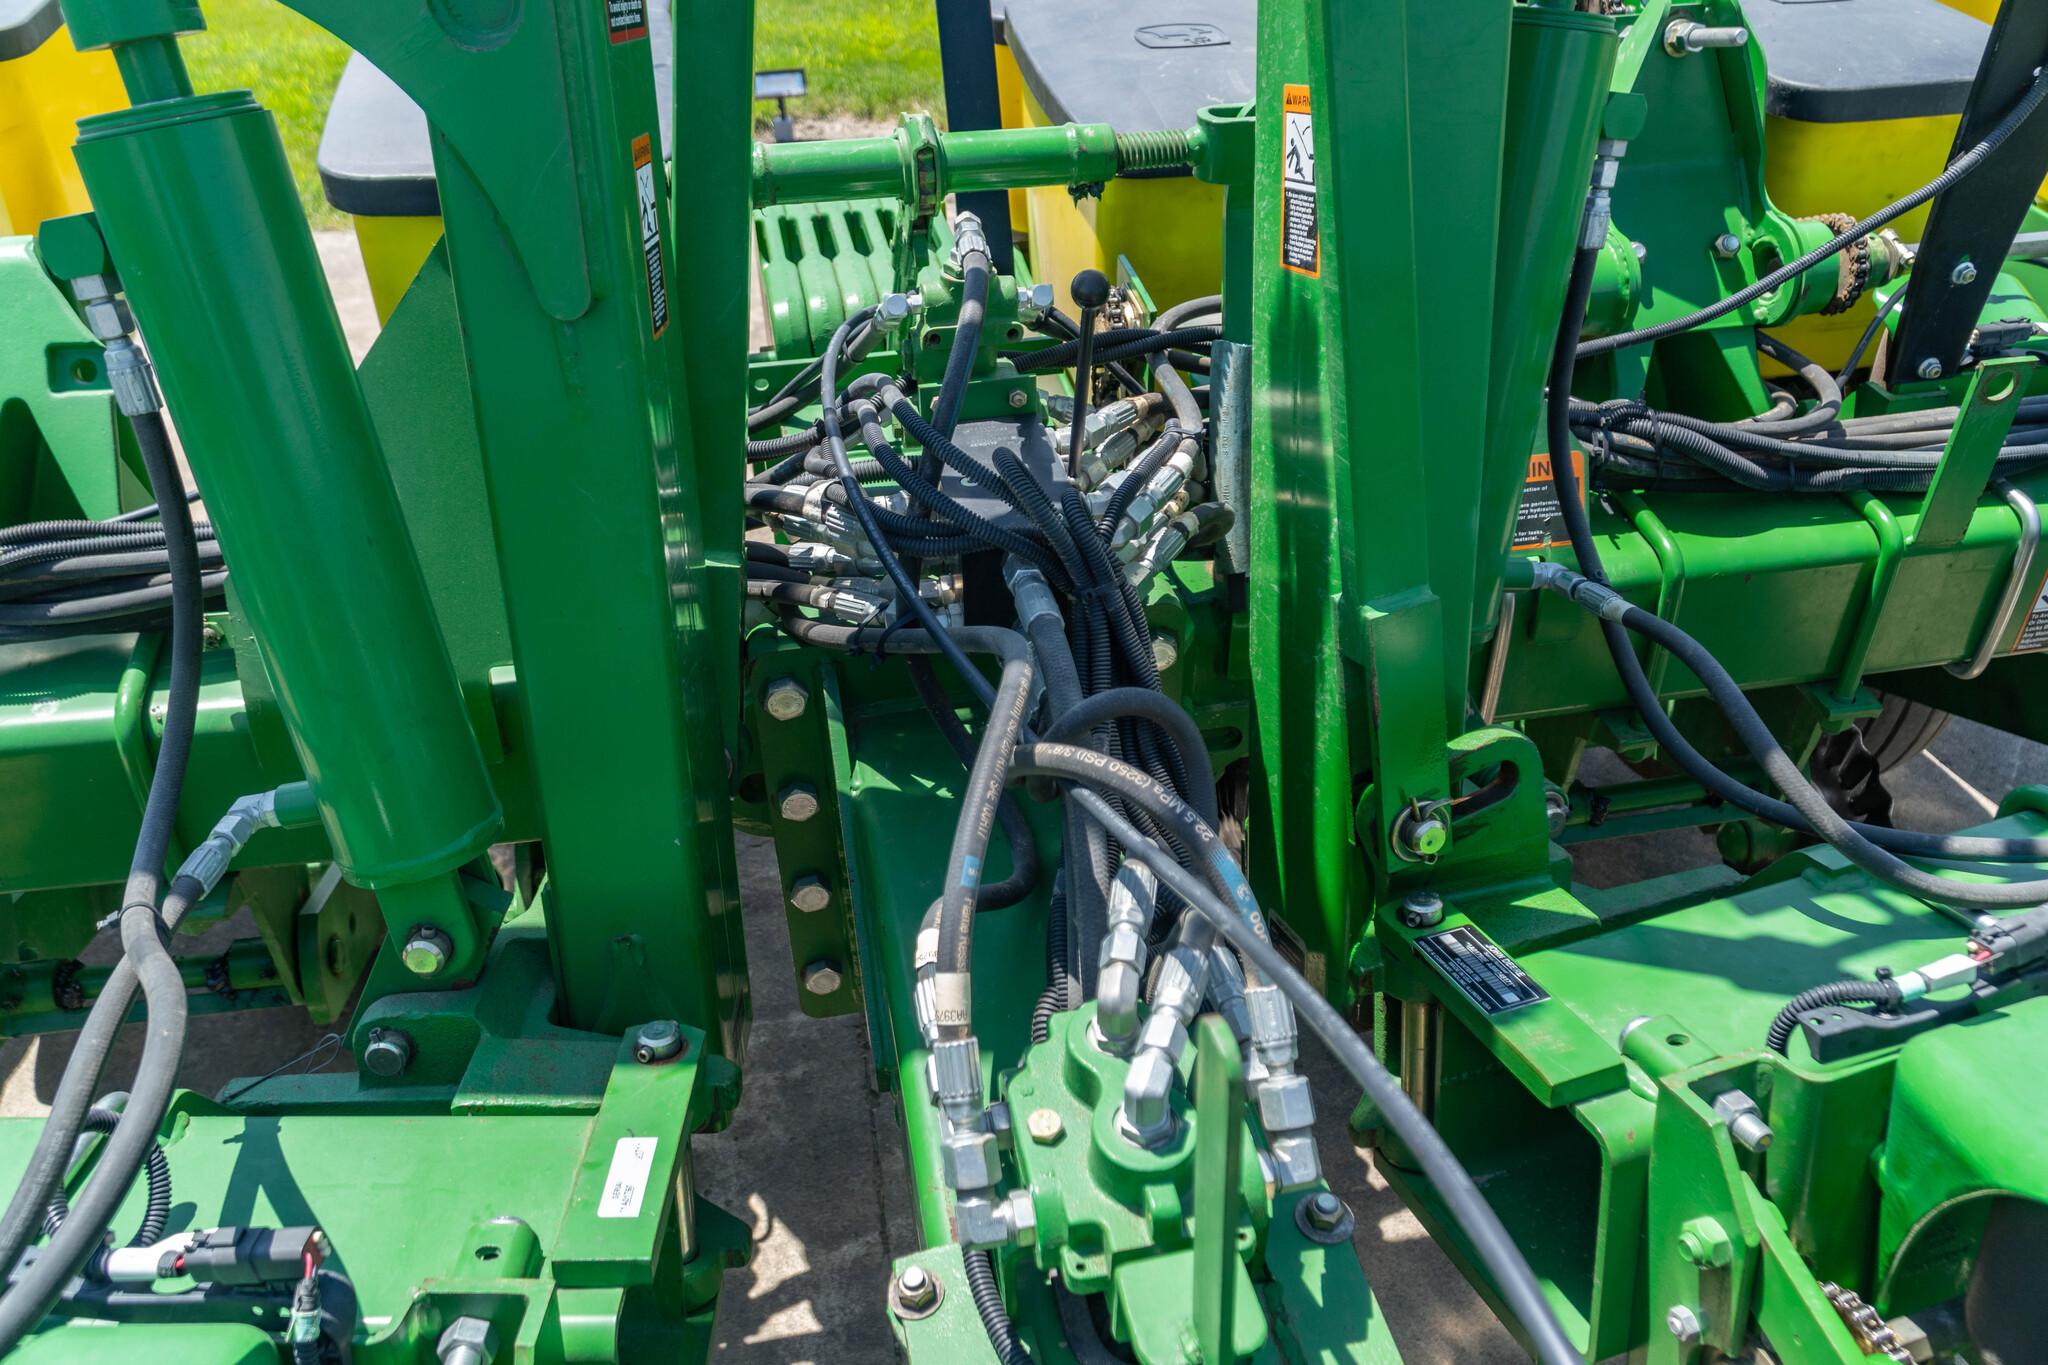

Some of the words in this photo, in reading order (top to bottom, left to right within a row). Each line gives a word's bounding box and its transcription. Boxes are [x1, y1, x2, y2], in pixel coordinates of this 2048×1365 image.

[1076, 750, 1108, 768] PSI)
[1110, 762, 1151, 788] (3250
[1154, 786, 1186, 814] MPa
[1185, 812, 1214, 842] 22.5
[960, 896, 974, 934] Flame
[1485, 944, 1505, 958] JOHN
[1502, 959, 1526, 977] DEERE
